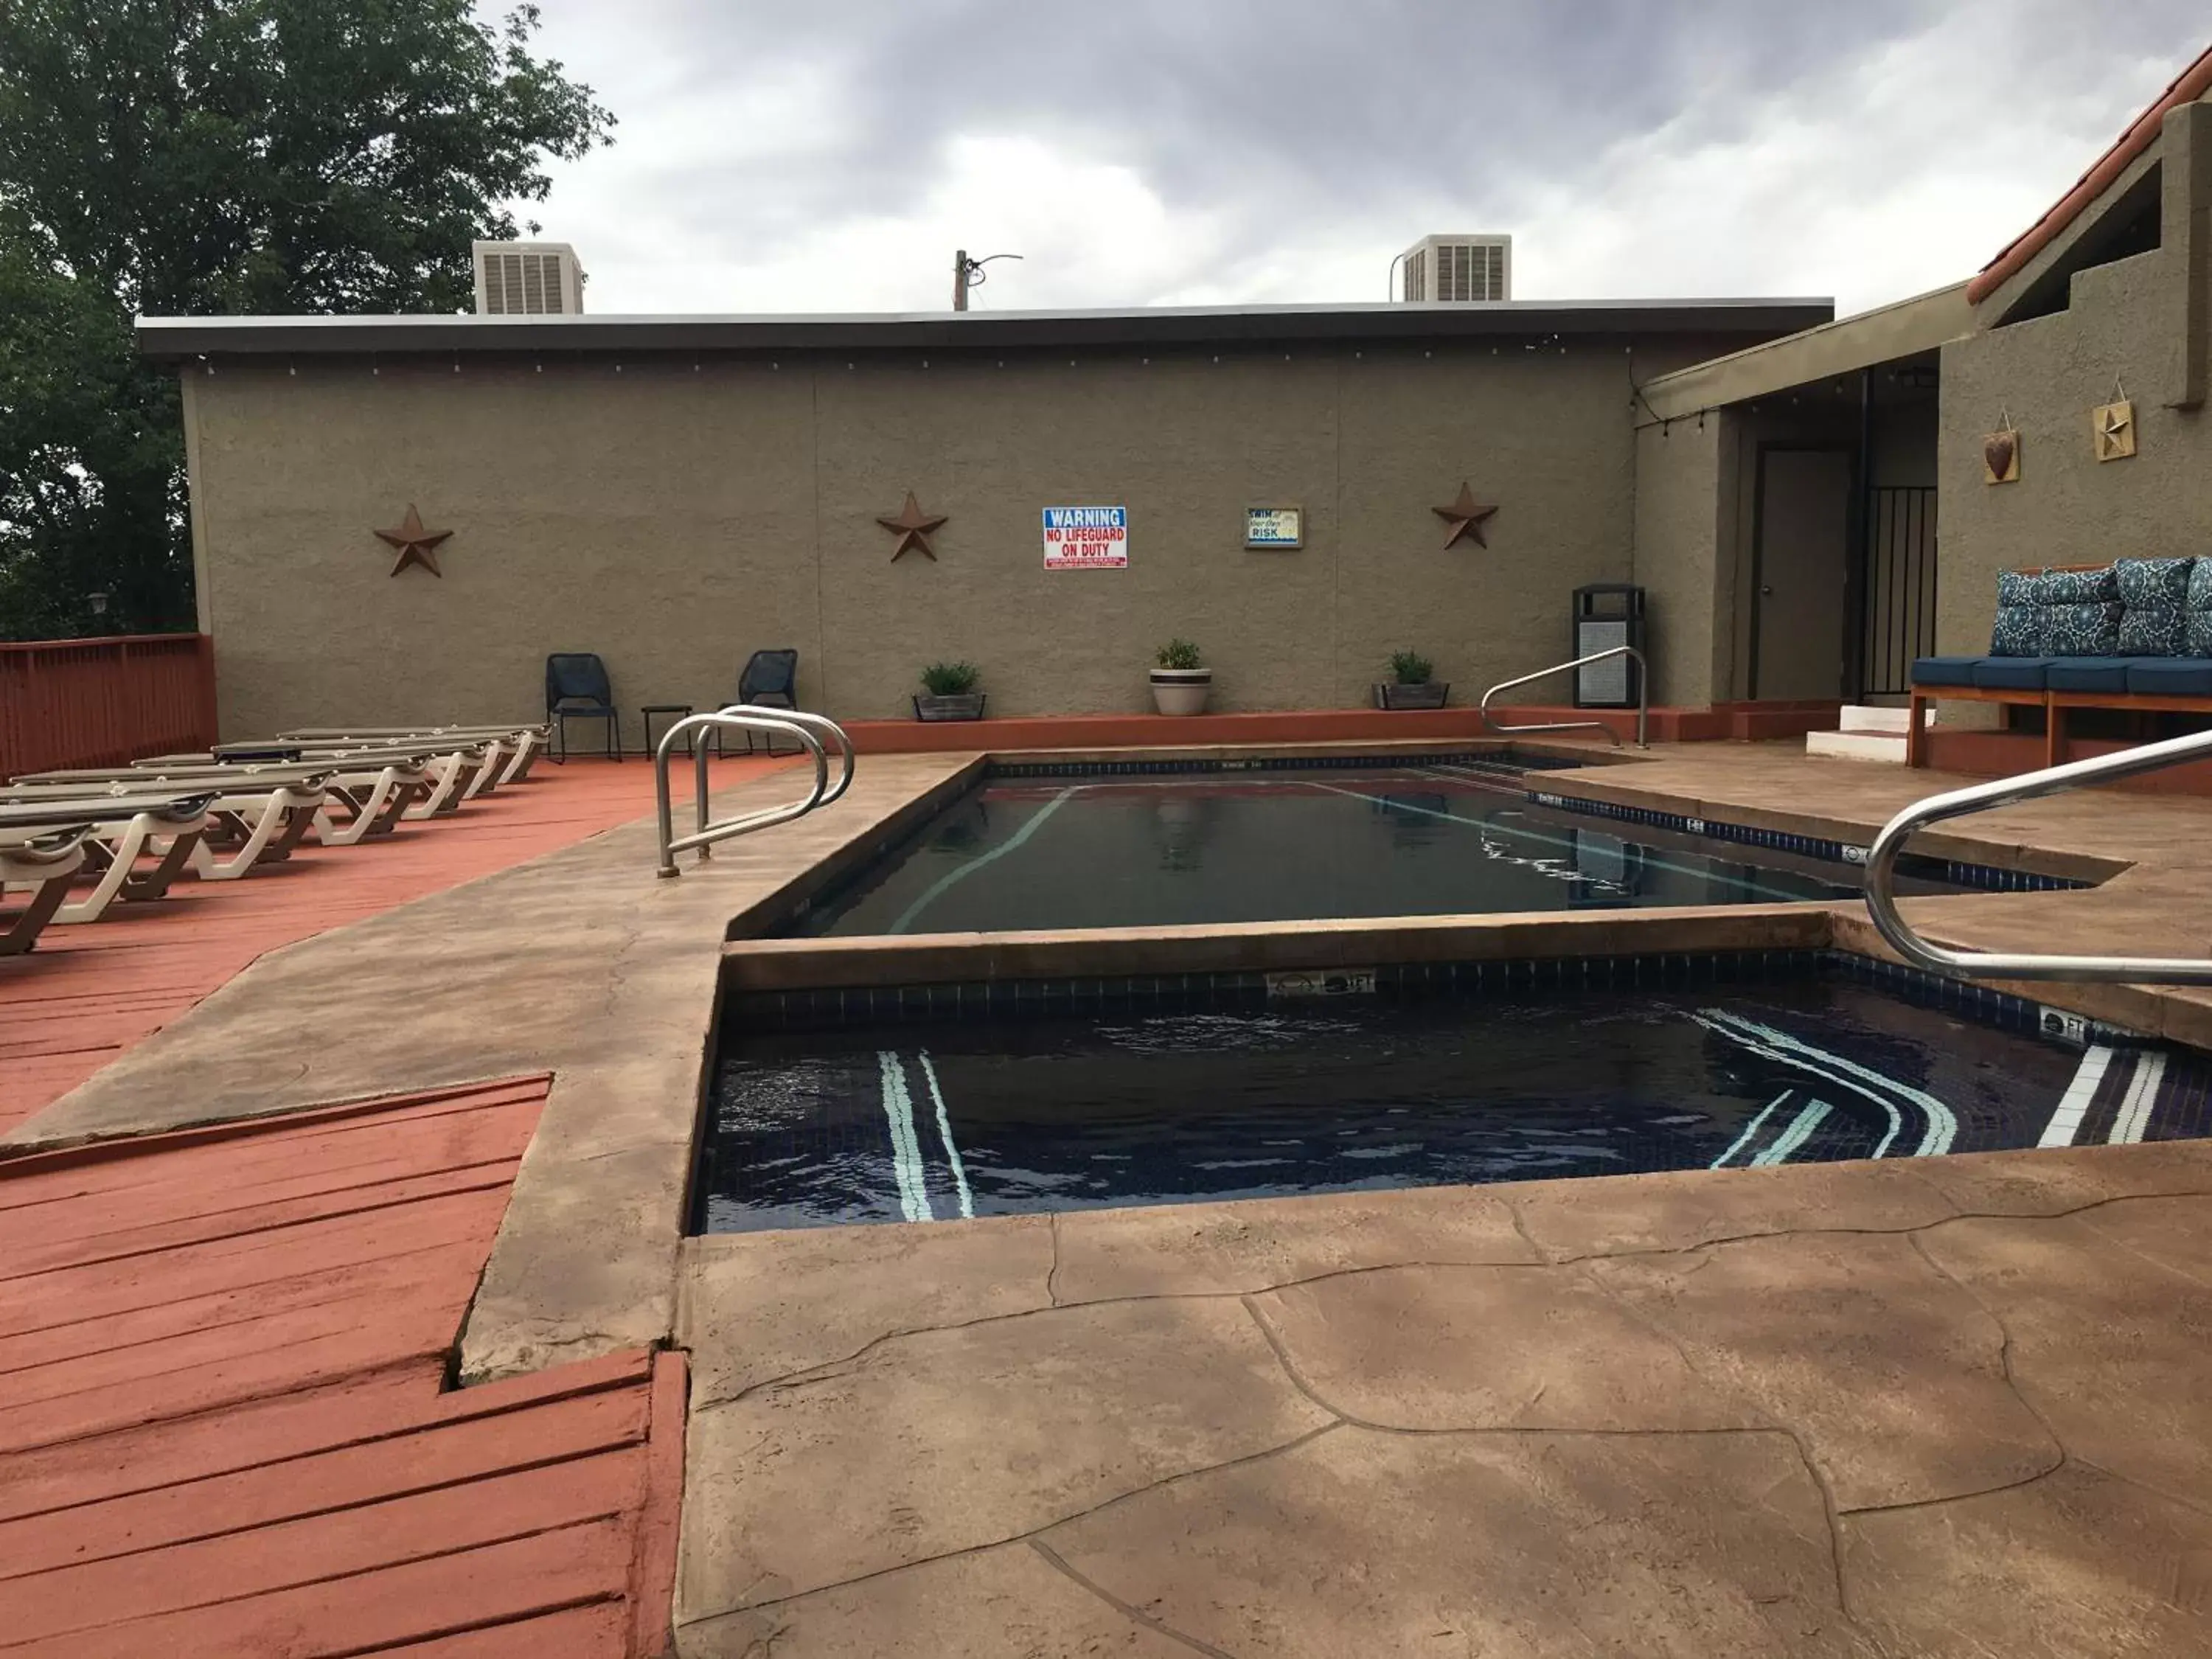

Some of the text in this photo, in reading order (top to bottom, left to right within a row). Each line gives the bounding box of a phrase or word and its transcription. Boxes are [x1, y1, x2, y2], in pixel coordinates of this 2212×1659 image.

[1051, 509, 1120, 527] WARNING
[1047, 528, 1124, 542] NO LIFEGUARD
[1253, 528, 1278, 537] RISK
[1062, 543, 1109, 556] ON DUTY
[2067, 1017, 2083, 1034] FT
